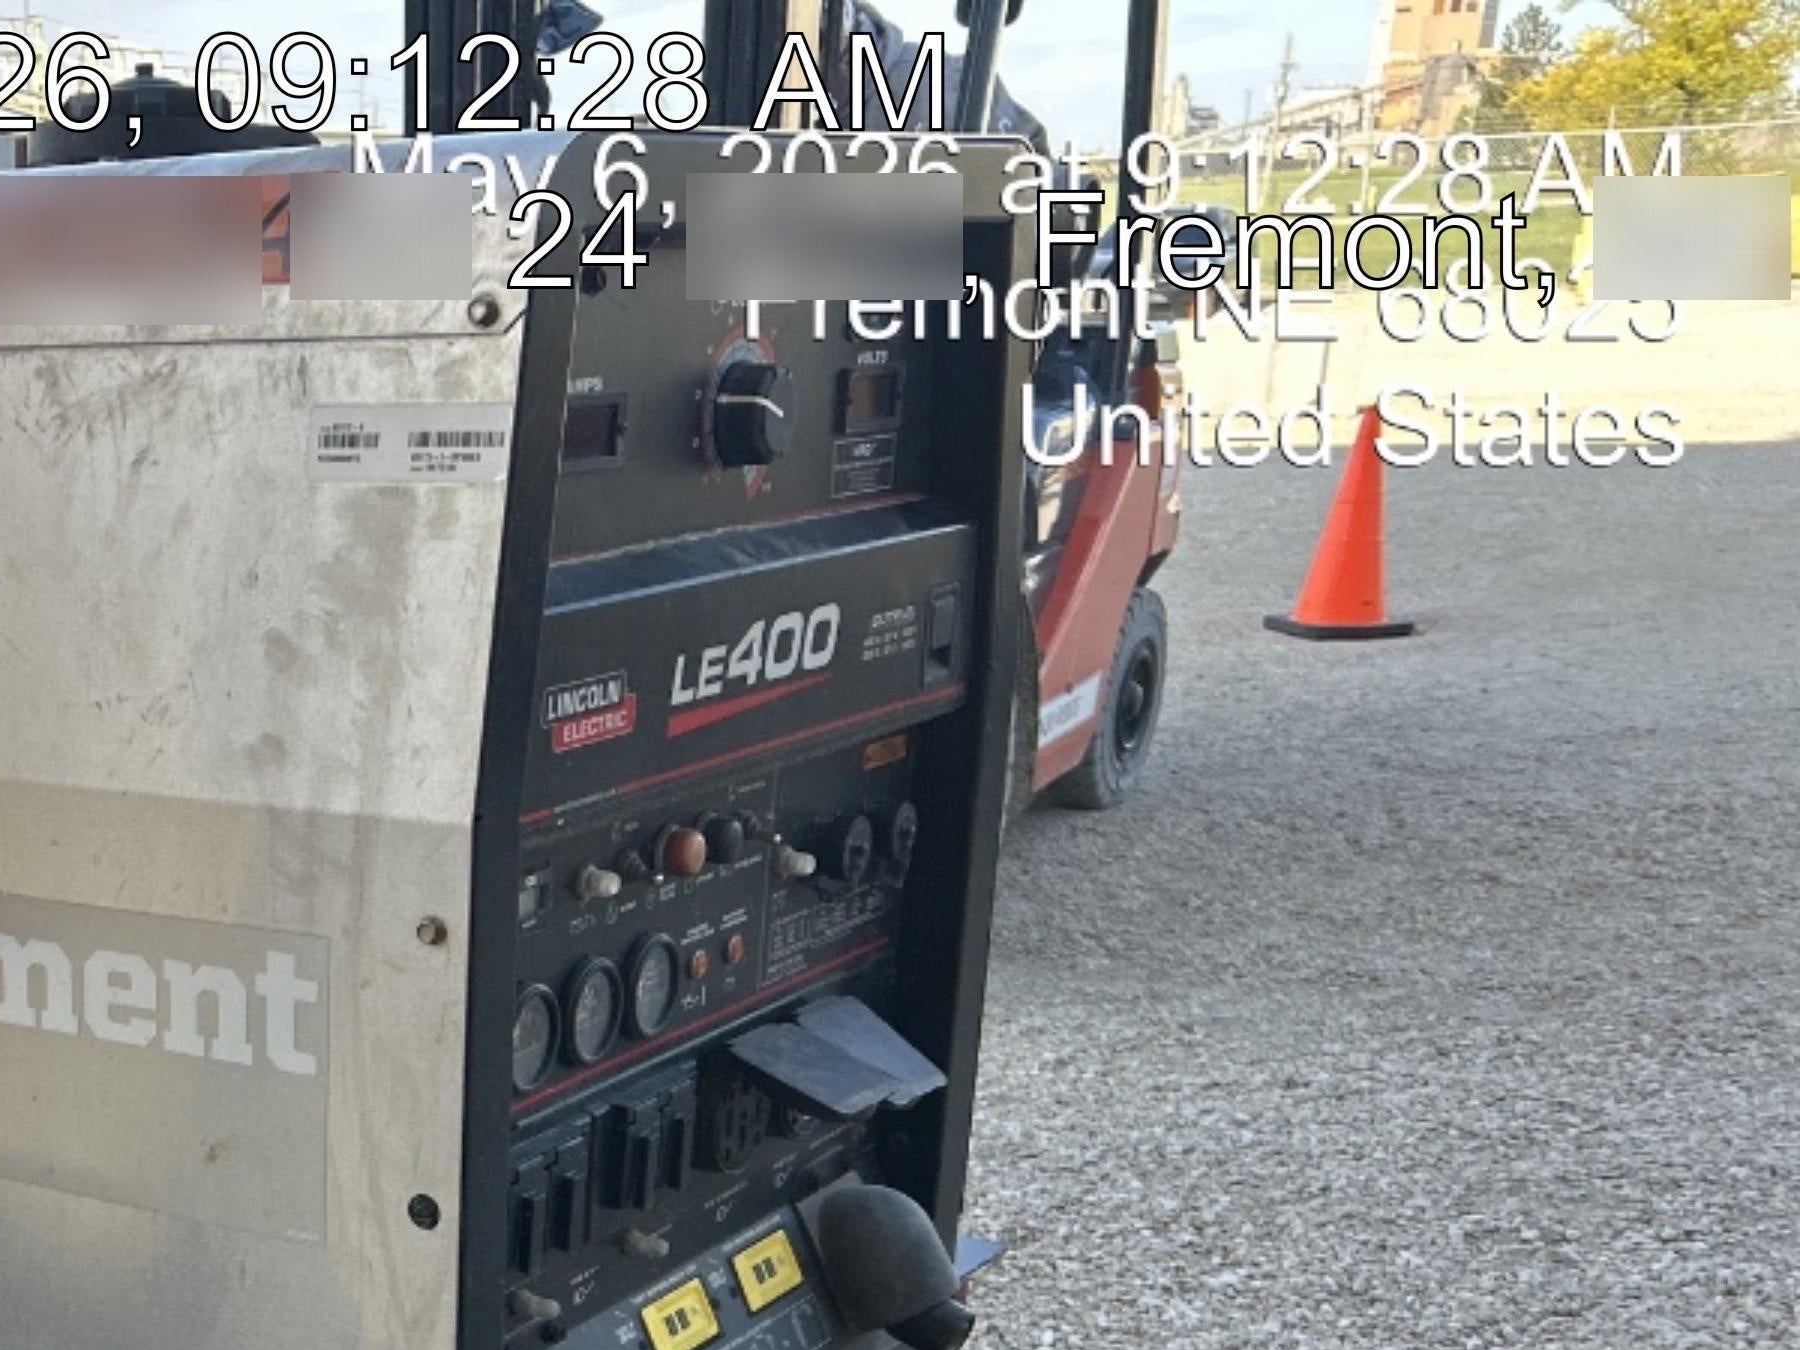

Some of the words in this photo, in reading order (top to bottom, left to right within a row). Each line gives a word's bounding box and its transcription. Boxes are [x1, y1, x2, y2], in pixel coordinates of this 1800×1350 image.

[670, 602, 841, 706] LE400
[548, 678, 622, 720] LINCOLN
[562, 710, 628, 744] ELECTRIC
